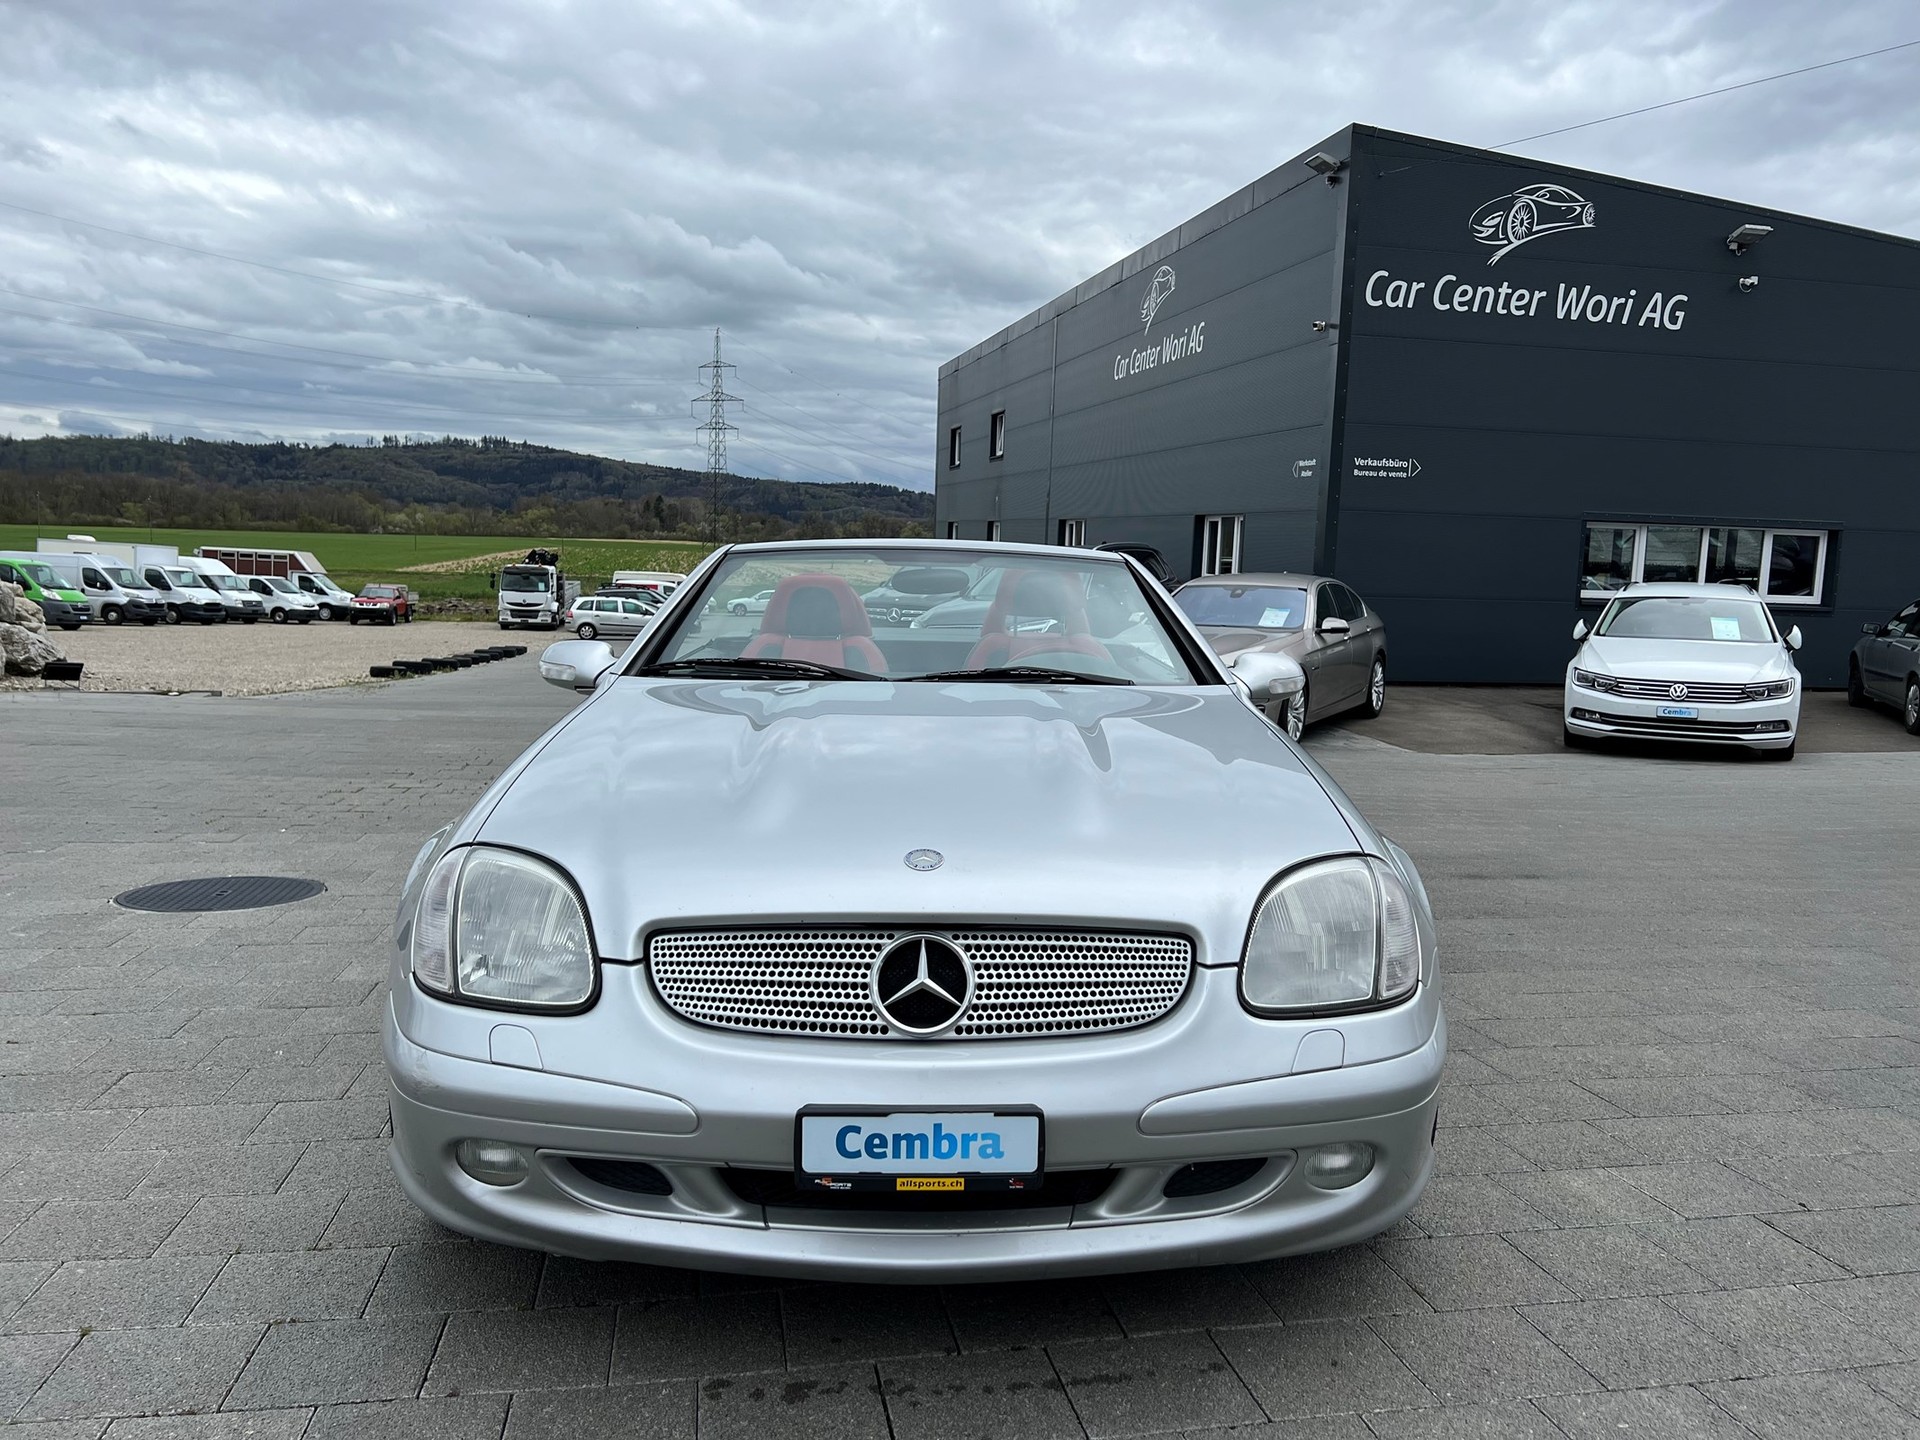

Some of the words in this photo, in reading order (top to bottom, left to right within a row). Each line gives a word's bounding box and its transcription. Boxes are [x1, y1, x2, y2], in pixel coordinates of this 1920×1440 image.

[1364, 270, 1425, 309] Car
[1433, 274, 1547, 317] Center
[1556, 283, 1637, 325] Wori
[1638, 292, 1689, 332] AG
[1114, 355, 1130, 380] Car
[1130, 345, 1161, 375] Center
[1162, 328, 1188, 364] Wori
[1187, 321, 1205, 356] AG
[1353, 469, 1378, 477] Bureau
[1354, 457, 1408, 468] Verkaufsbüro
[835, 1122, 1005, 1160] Cembra
[899, 1180, 963, 1189] allsports.ch
